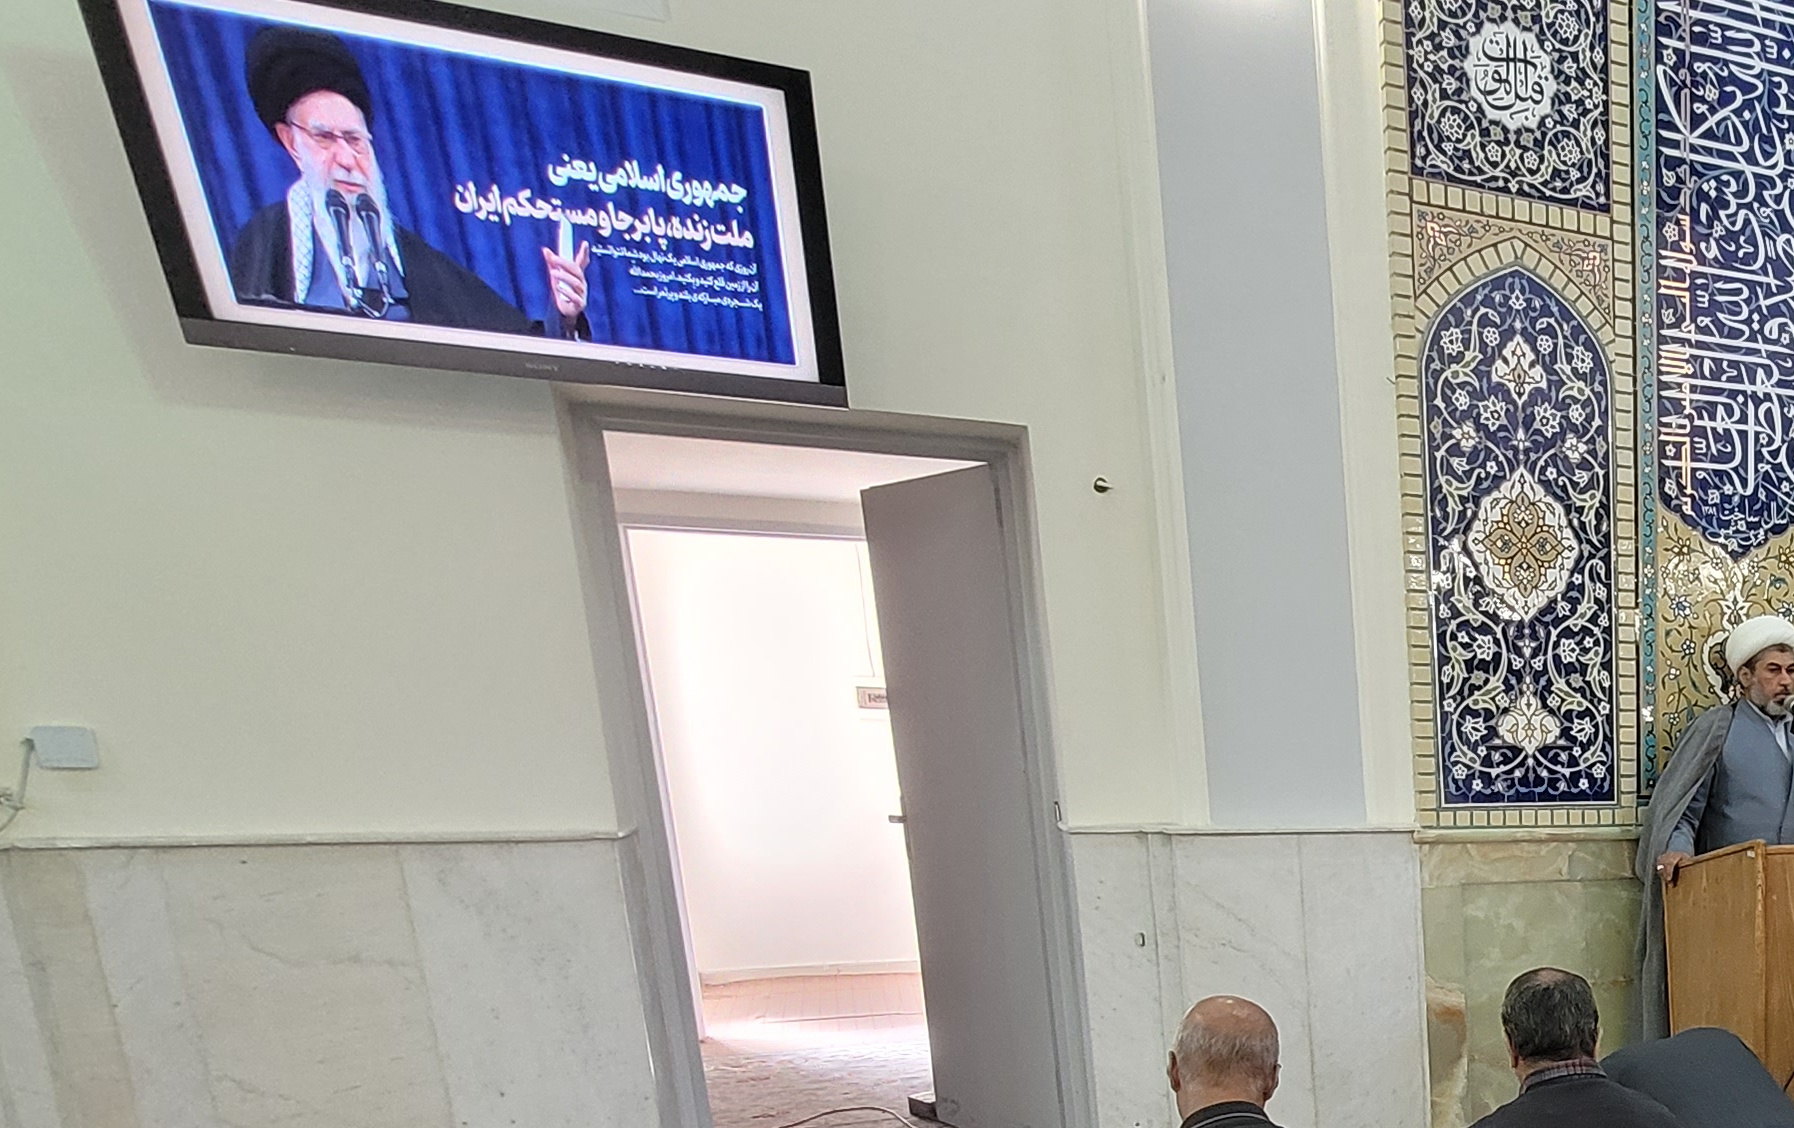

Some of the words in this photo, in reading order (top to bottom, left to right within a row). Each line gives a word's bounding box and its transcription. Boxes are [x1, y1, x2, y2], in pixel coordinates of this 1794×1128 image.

[547, 153, 599, 192] یعنی
[599, 160, 666, 194] اسلامی
[454, 181, 503, 222] ایران
[503, 189, 600, 227] مستحکم
[666, 171, 748, 214] جمهوری
[711, 220, 754, 248] ملت
